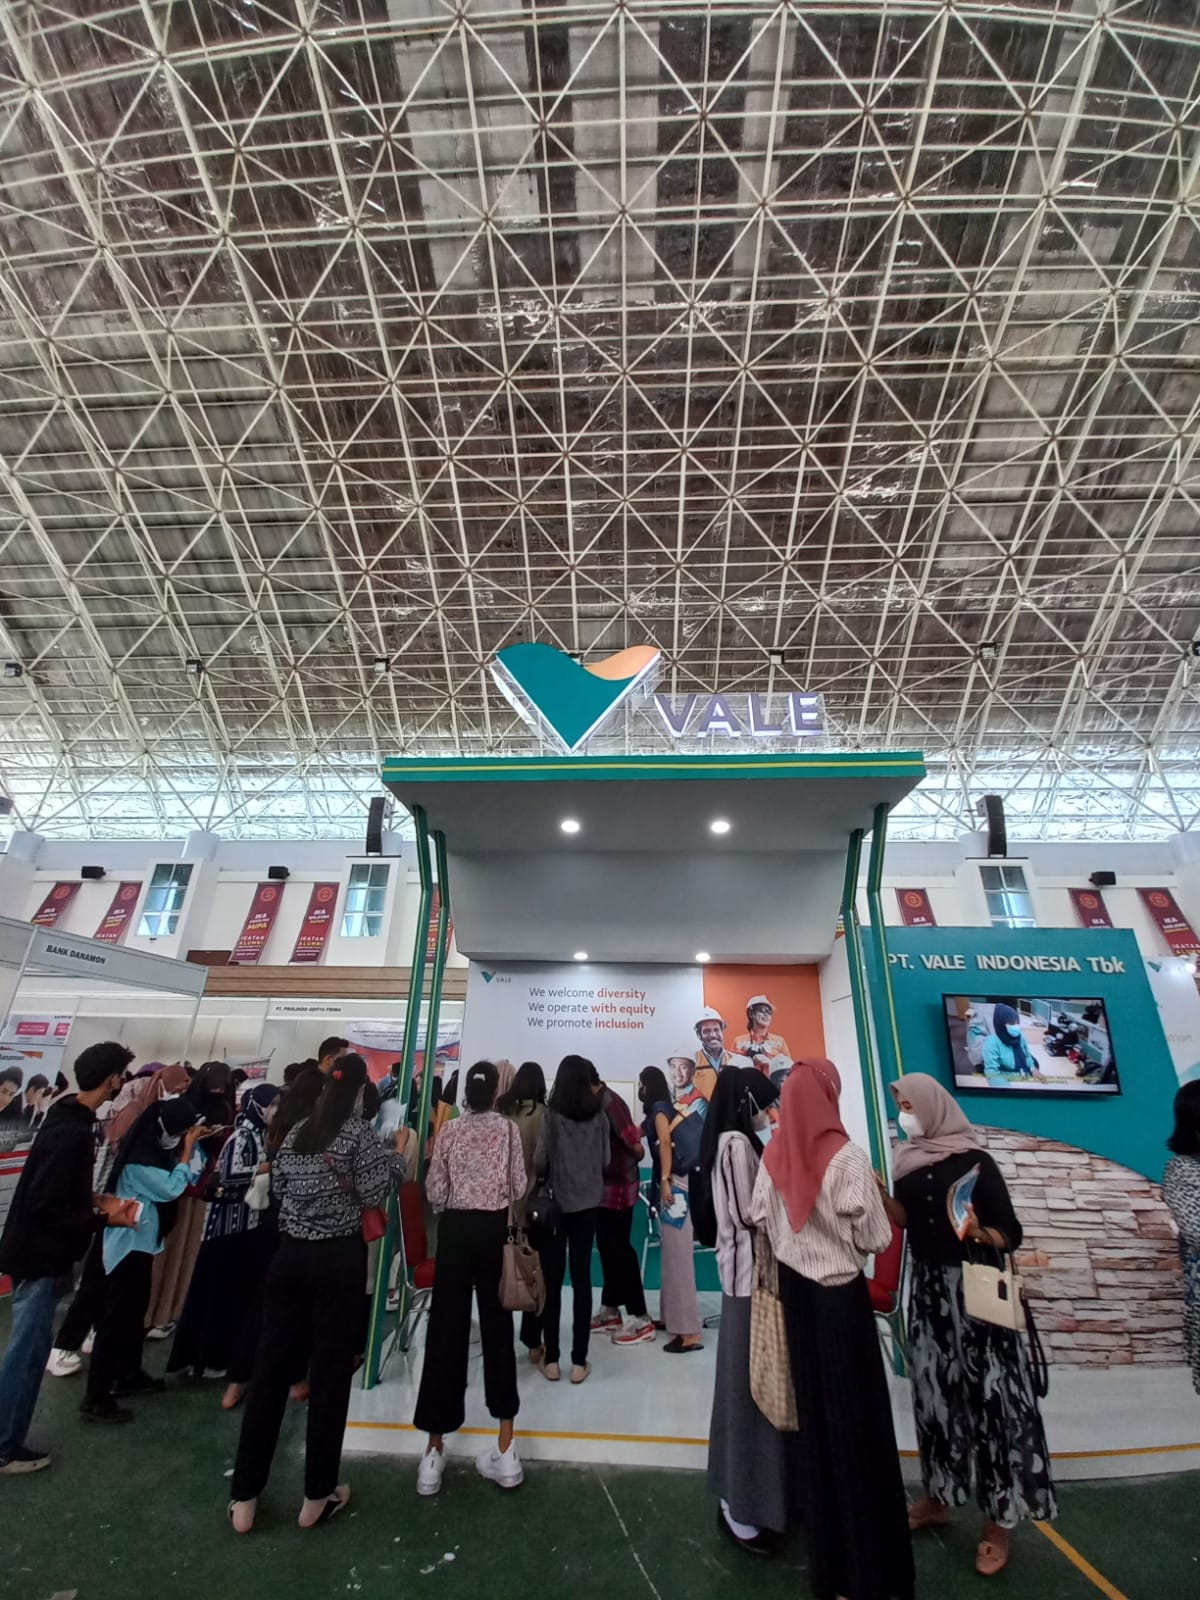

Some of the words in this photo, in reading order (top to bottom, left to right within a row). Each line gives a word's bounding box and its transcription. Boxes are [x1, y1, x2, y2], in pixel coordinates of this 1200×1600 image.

[654, 692, 823, 738] VALE
[46, 944, 69, 957] BANK
[69, 949, 107, 965] DANAMON
[919, 954, 967, 970] VALE
[976, 954, 1081, 972] INDONESIA
[1086, 956, 1126, 974] Tbk
[529, 987, 546, 997] We
[548, 987, 595, 999] welcome
[597, 988, 646, 1001] diversity
[528, 1002, 545, 1012] We
[547, 1003, 588, 1014] operate
[591, 1003, 617, 1014] with
[619, 1004, 656, 1017] equity
[527, 1017, 544, 1027] We
[546, 1019, 593, 1030] promote
[595, 1018, 645, 1029] inclusion
